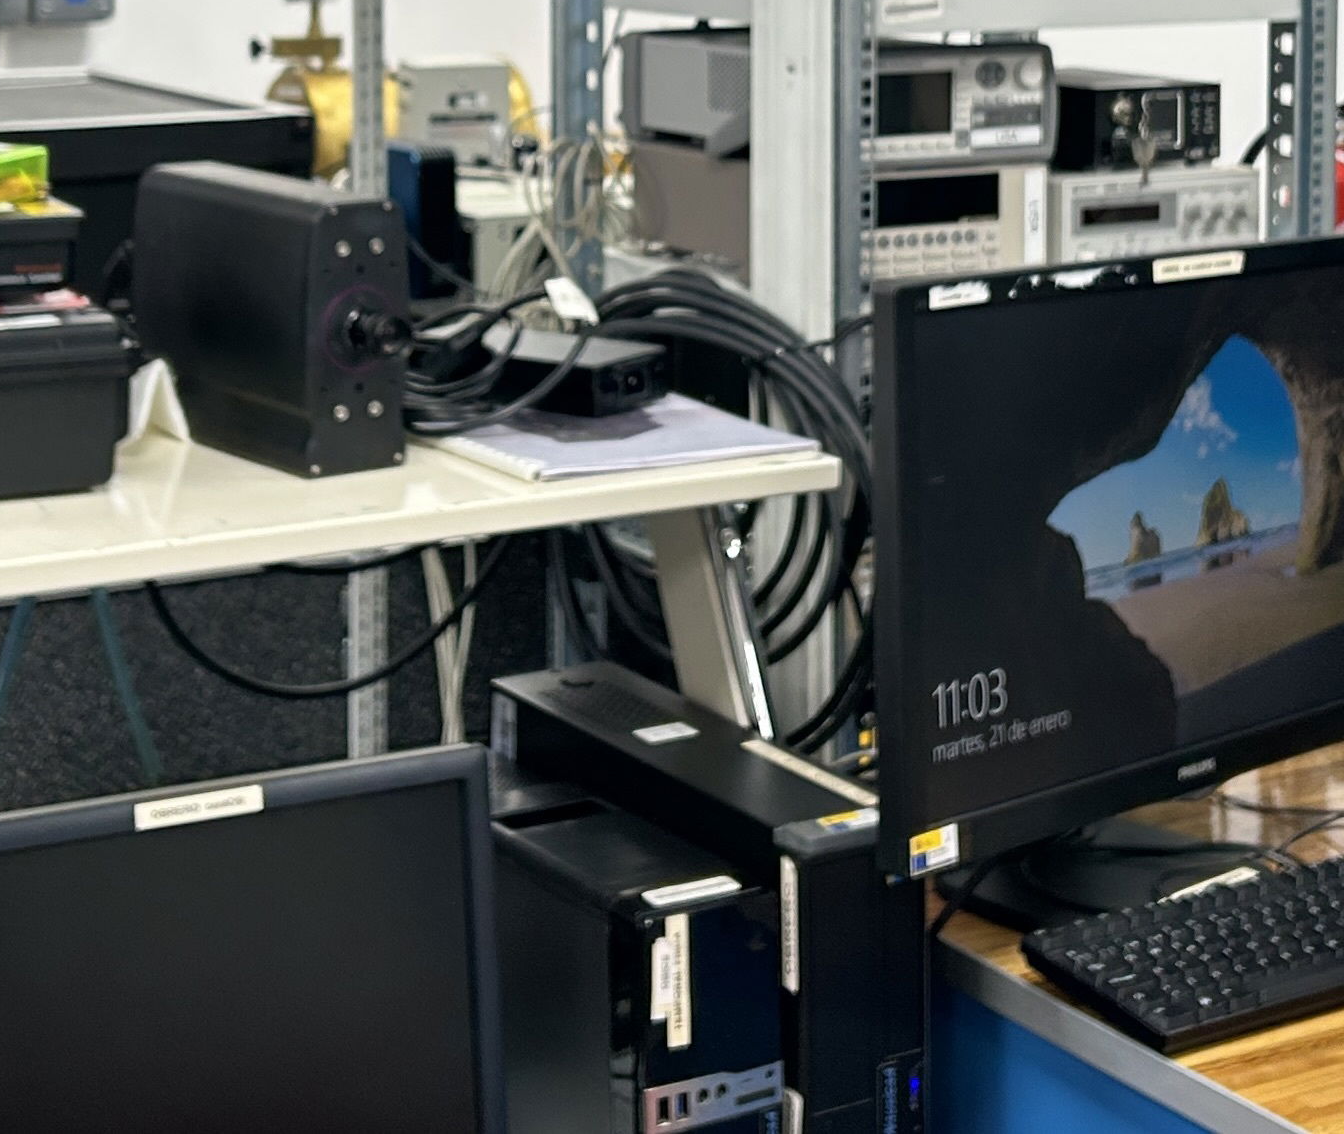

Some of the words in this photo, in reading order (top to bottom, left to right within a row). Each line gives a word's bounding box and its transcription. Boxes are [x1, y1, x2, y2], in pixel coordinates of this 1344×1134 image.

[931, 667, 1008, 729] 11:03
[988, 722, 1006, 748] 21
[1007, 718, 1028, 744] de
[1029, 709, 1072, 738] enero
